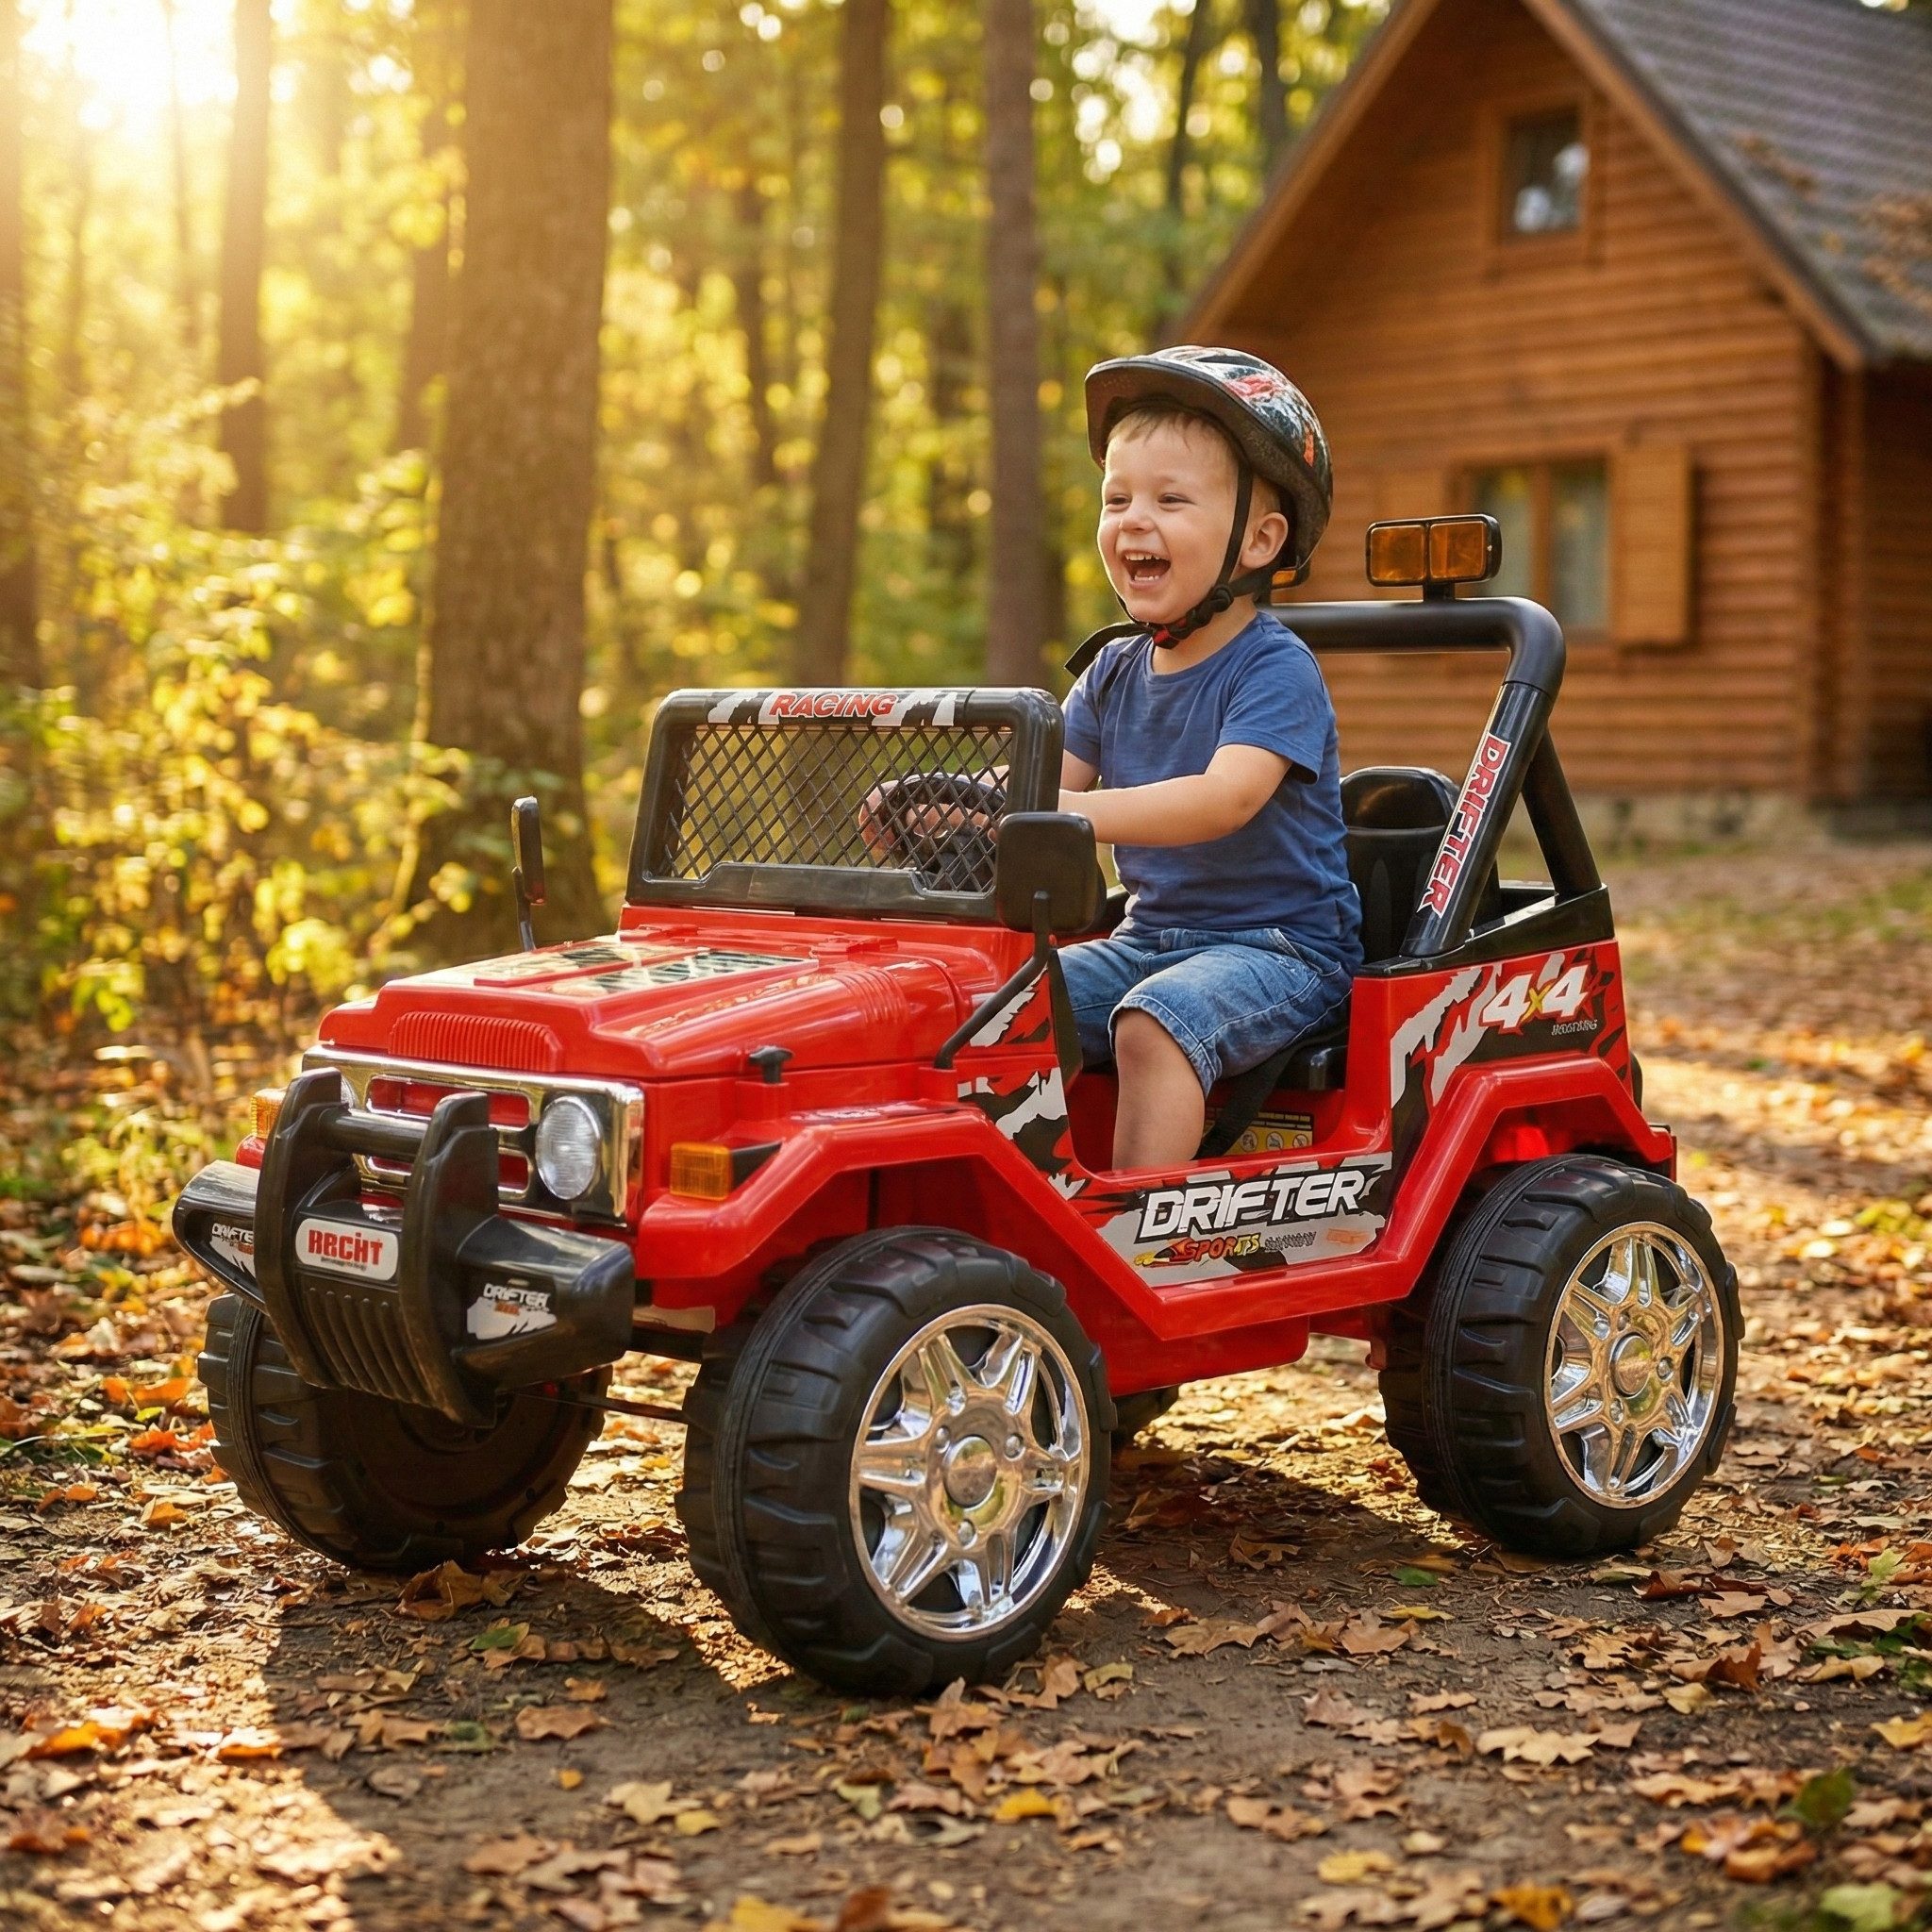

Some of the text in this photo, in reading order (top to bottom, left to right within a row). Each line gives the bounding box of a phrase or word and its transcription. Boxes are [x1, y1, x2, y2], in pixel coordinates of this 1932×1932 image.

[768, 693, 898, 717] RACING
[1417, 733, 1511, 919] DRIFTER
[1482, 964, 1589, 1029] 4x4
[1140, 1171, 1365, 1239] DRIFTER
[211, 1223, 255, 1244] DRIFTE
[1175, 1232, 1261, 1261] SPORTS
[483, 1283, 551, 1307] DRIFTER
